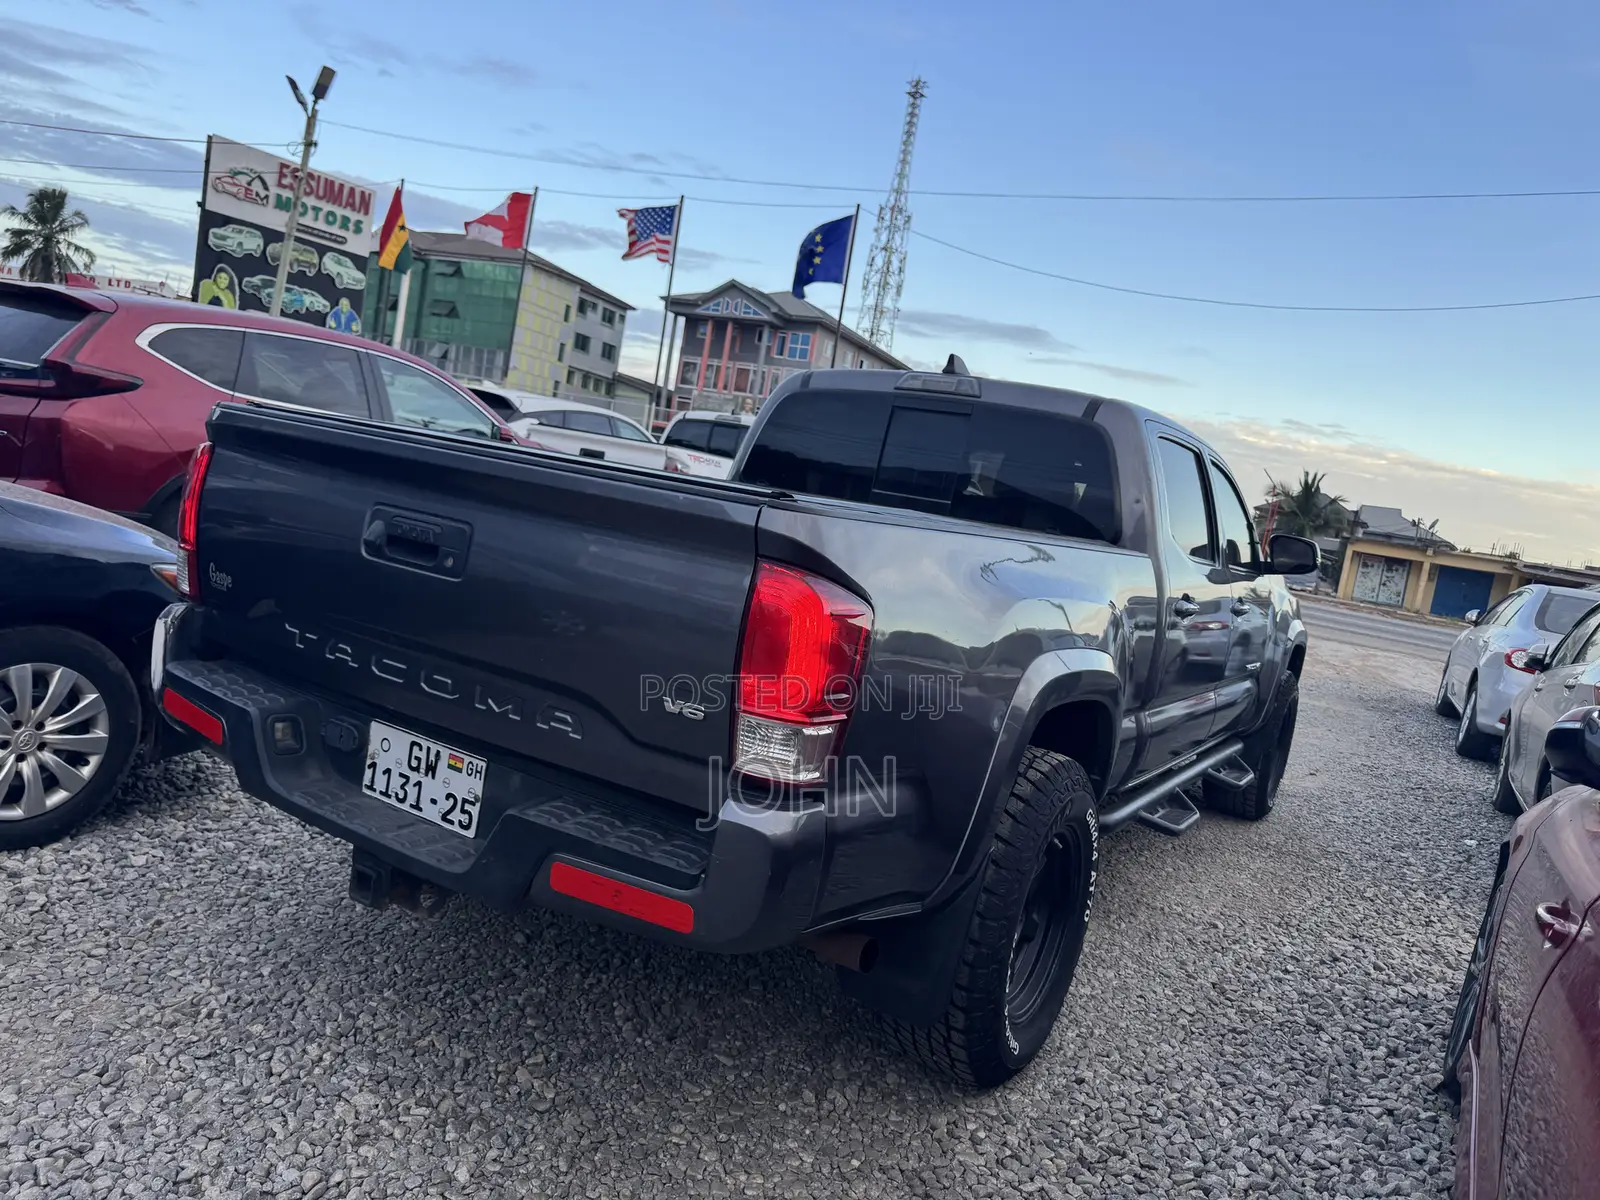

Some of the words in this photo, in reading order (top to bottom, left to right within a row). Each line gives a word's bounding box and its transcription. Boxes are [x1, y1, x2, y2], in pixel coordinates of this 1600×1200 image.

[277, 162, 372, 216] ESSUMAN
[274, 193, 364, 235] MOTORS
[107, 279, 131, 289] LTD
[285, 623, 582, 740] TACOMA
[662, 695, 705, 721] V6
[407, 740, 441, 780] GW
[466, 760, 484, 782] GH
[363, 761, 477, 831] 1131-25
